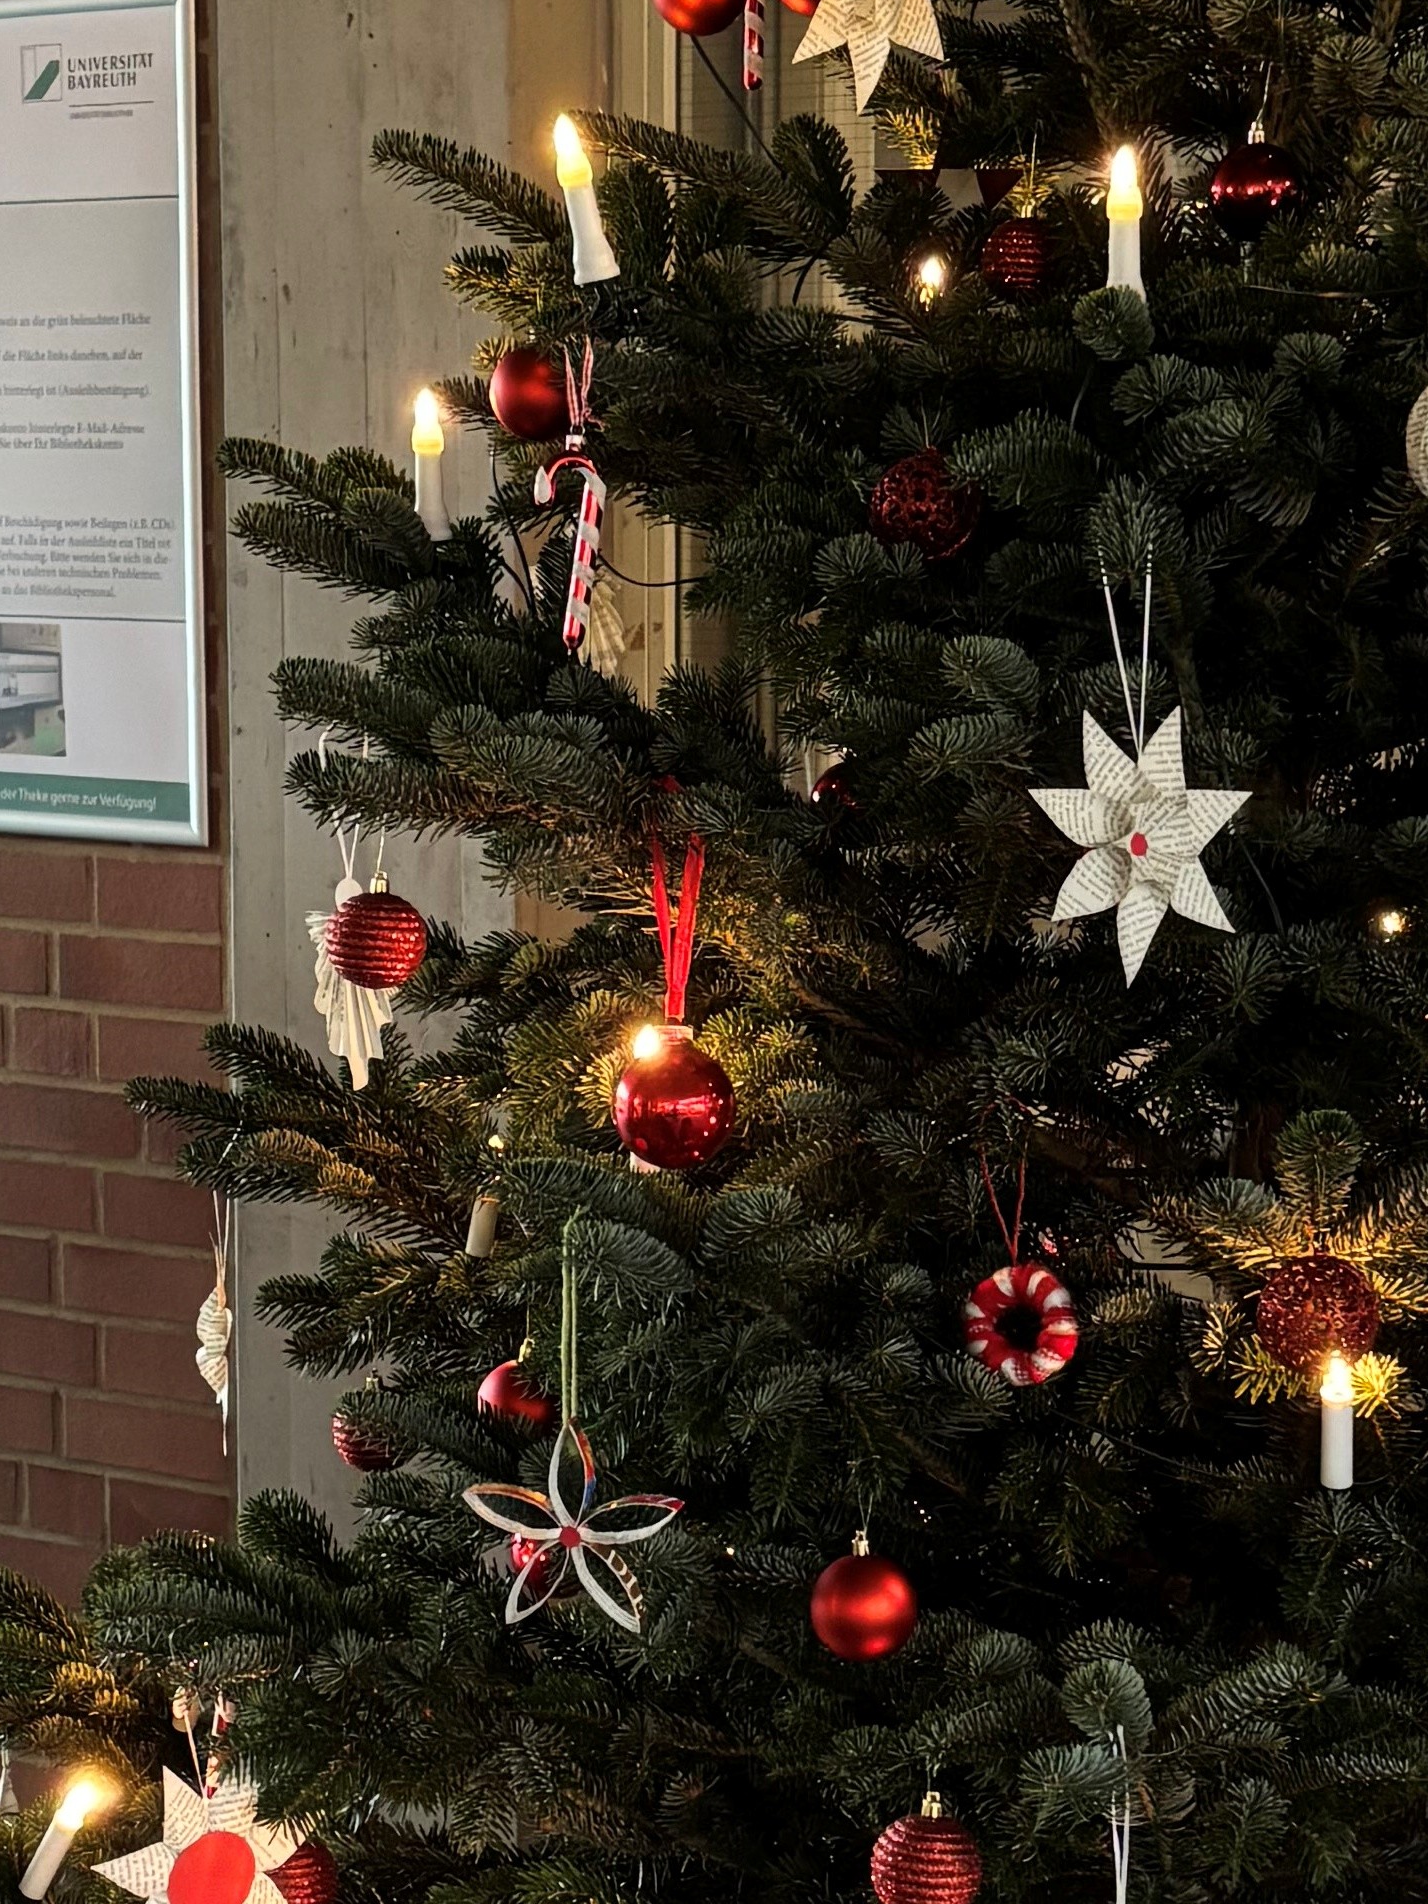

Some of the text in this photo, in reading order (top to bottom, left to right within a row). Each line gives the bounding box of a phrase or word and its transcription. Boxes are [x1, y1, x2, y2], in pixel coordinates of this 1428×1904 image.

[67, 71, 137, 91] BAYREUTH
[1, 787, 17, 800] der
[19, 787, 48, 803] Theke
[50, 793, 80, 807] gerne
[82, 794, 98, 806] zur
[99, 793, 157, 812] Verfügung!
